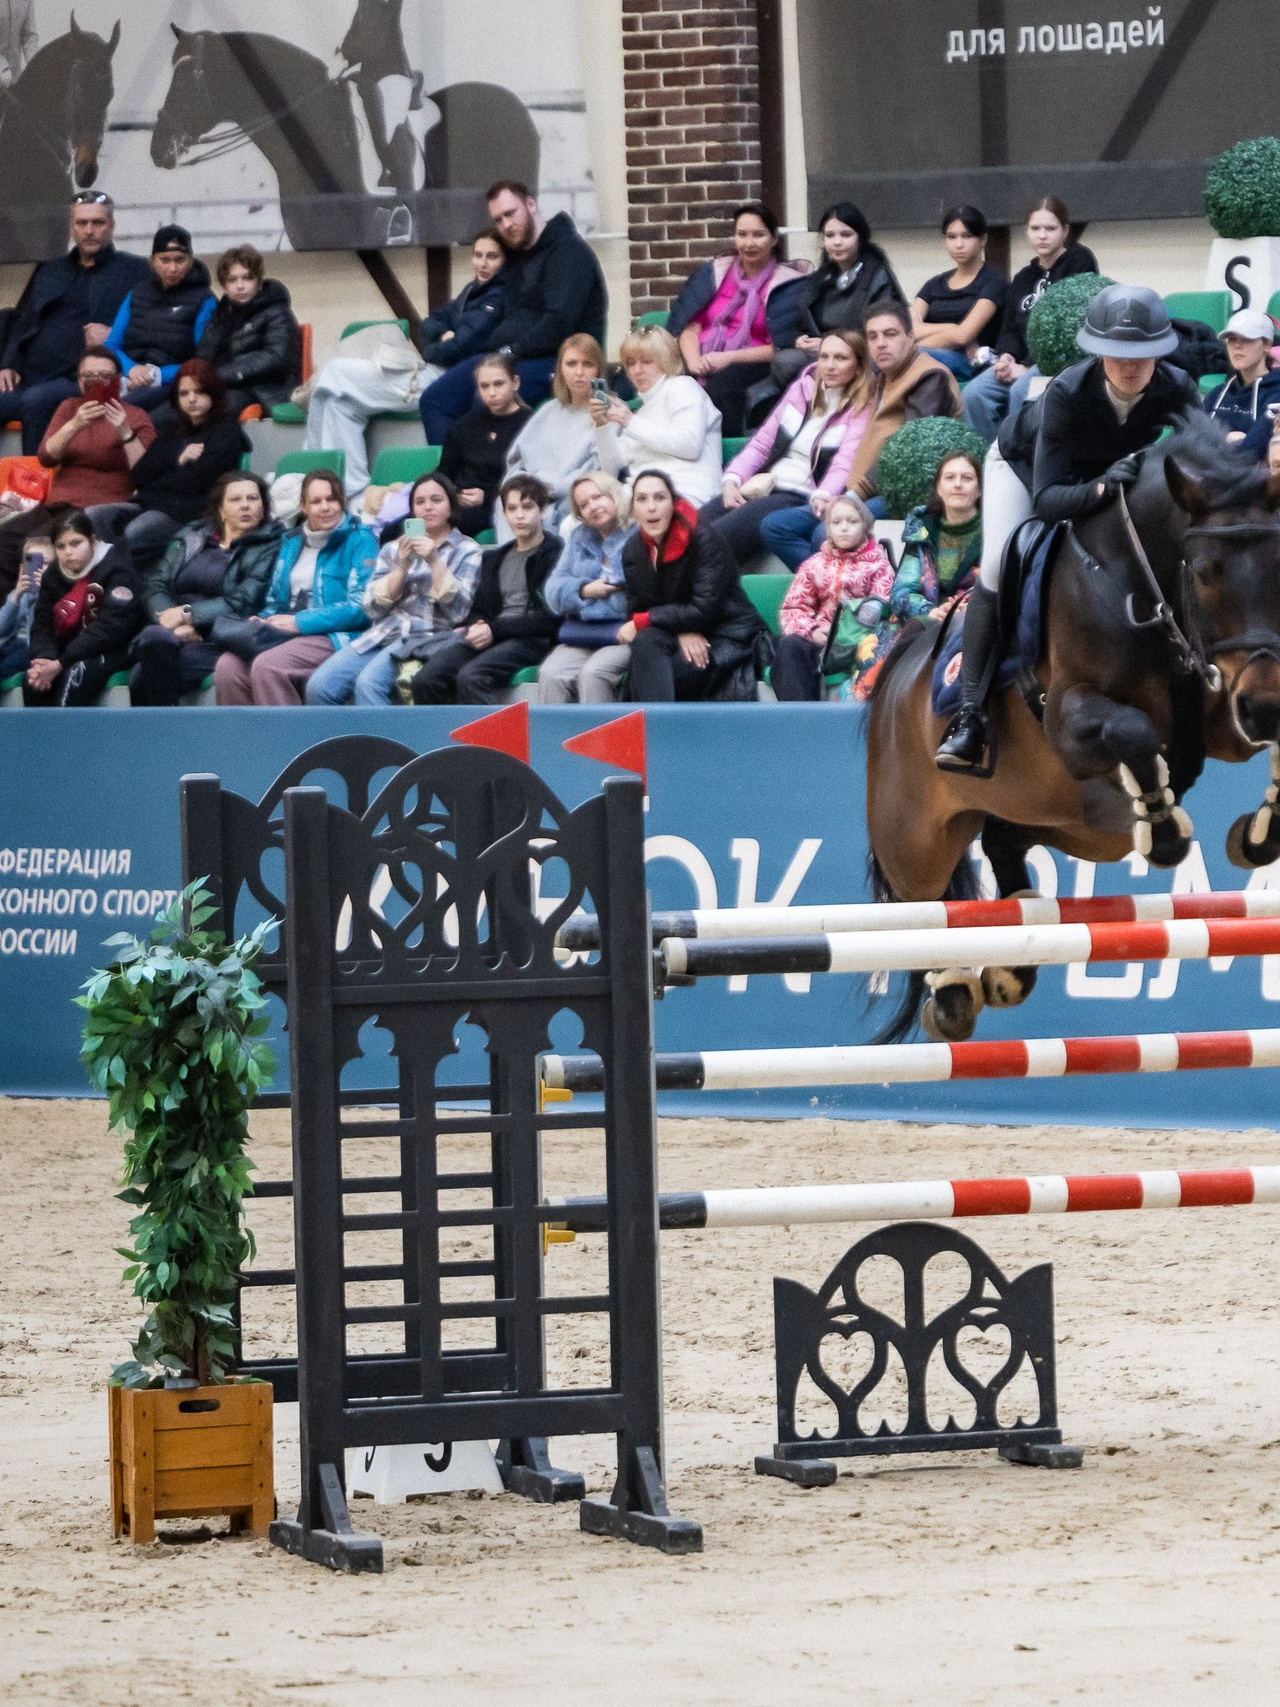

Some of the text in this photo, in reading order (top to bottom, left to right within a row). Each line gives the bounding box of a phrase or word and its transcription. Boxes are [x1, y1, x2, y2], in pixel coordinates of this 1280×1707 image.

[946, 6, 1165, 63] для лошадей
[0, 847, 132, 879] ФЕДЕРАЦИЯ
[102, 888, 184, 916] СПОРТ
[0, 927, 78, 956] ОССИИ
